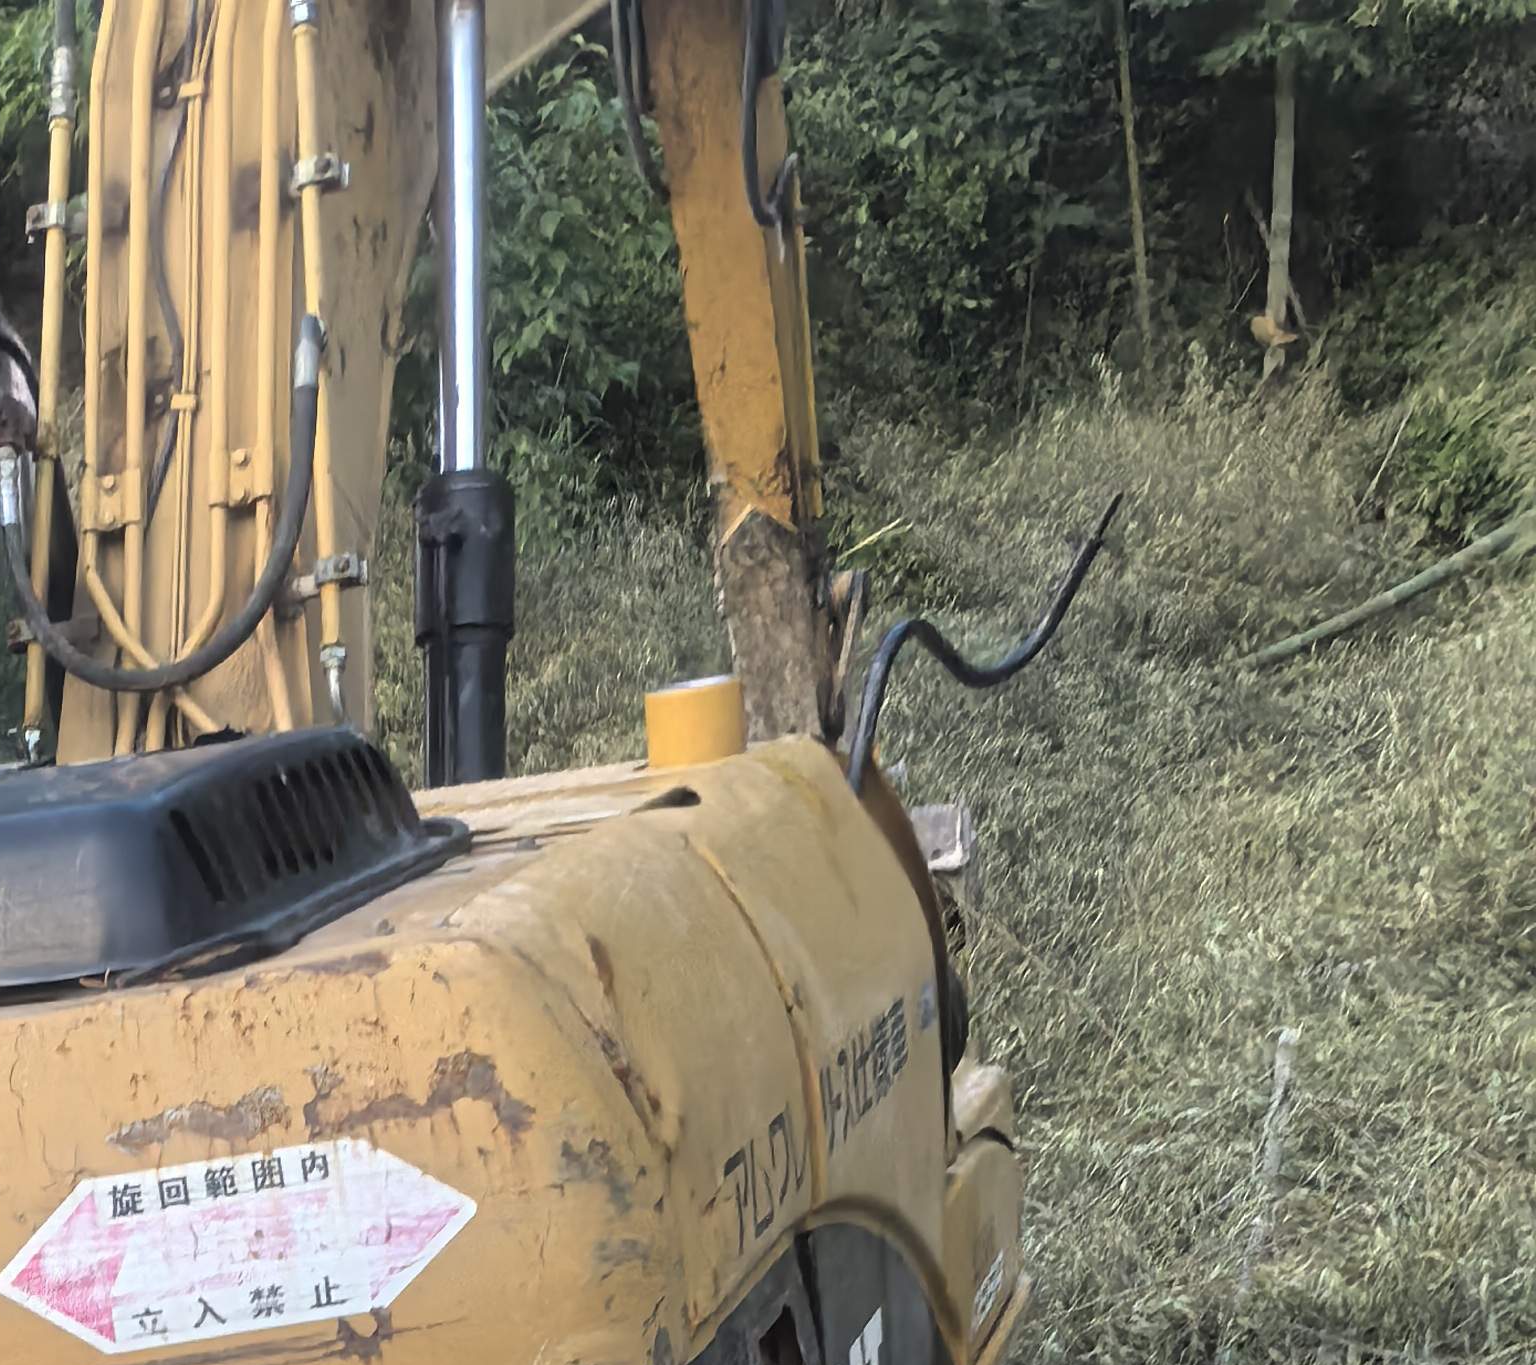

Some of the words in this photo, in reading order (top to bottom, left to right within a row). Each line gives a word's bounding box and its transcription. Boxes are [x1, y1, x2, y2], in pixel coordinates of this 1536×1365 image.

[108, 1150, 331, 1219] 旋回範囲内
[131, 1276, 349, 1341] 立入禁止
